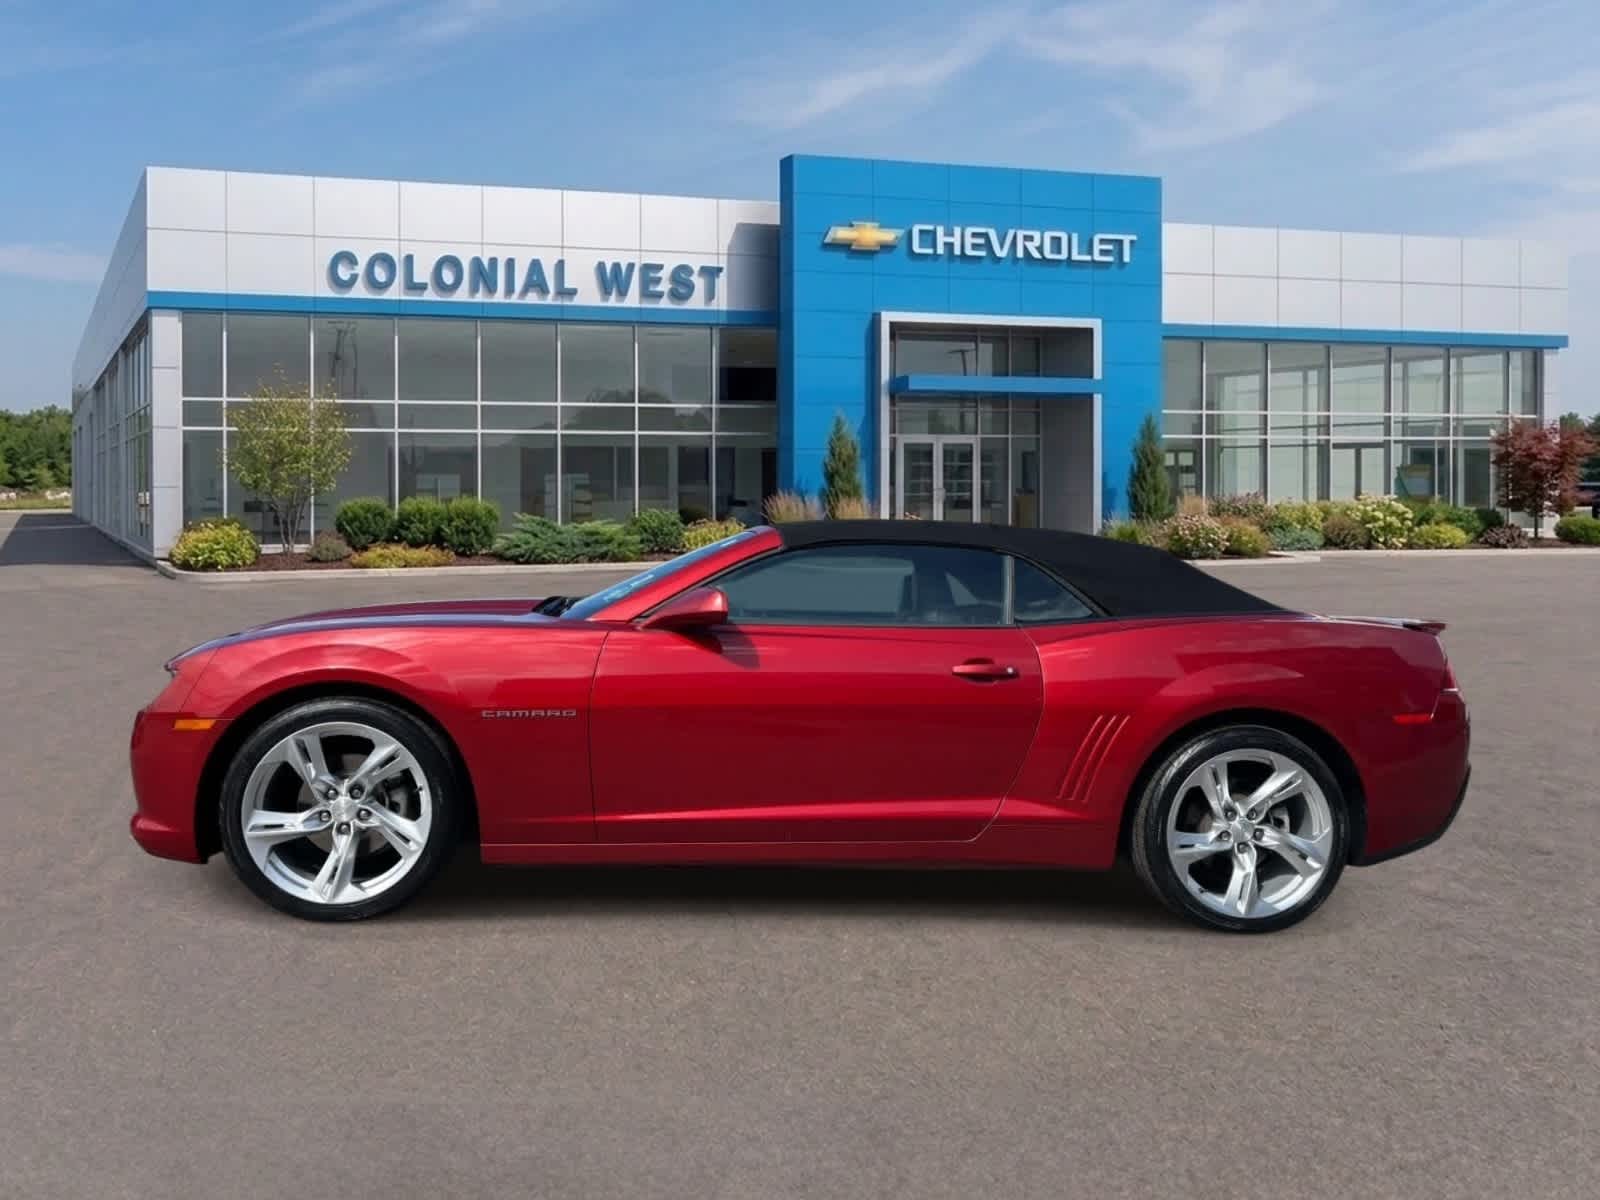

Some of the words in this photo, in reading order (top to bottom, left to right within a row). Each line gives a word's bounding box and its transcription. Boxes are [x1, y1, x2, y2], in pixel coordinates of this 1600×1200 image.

[911, 223, 1138, 264] CHEVROLET
[328, 250, 578, 297] COLONIAL
[596, 260, 724, 303] WEST
[481, 709, 577, 719] CAMARO
